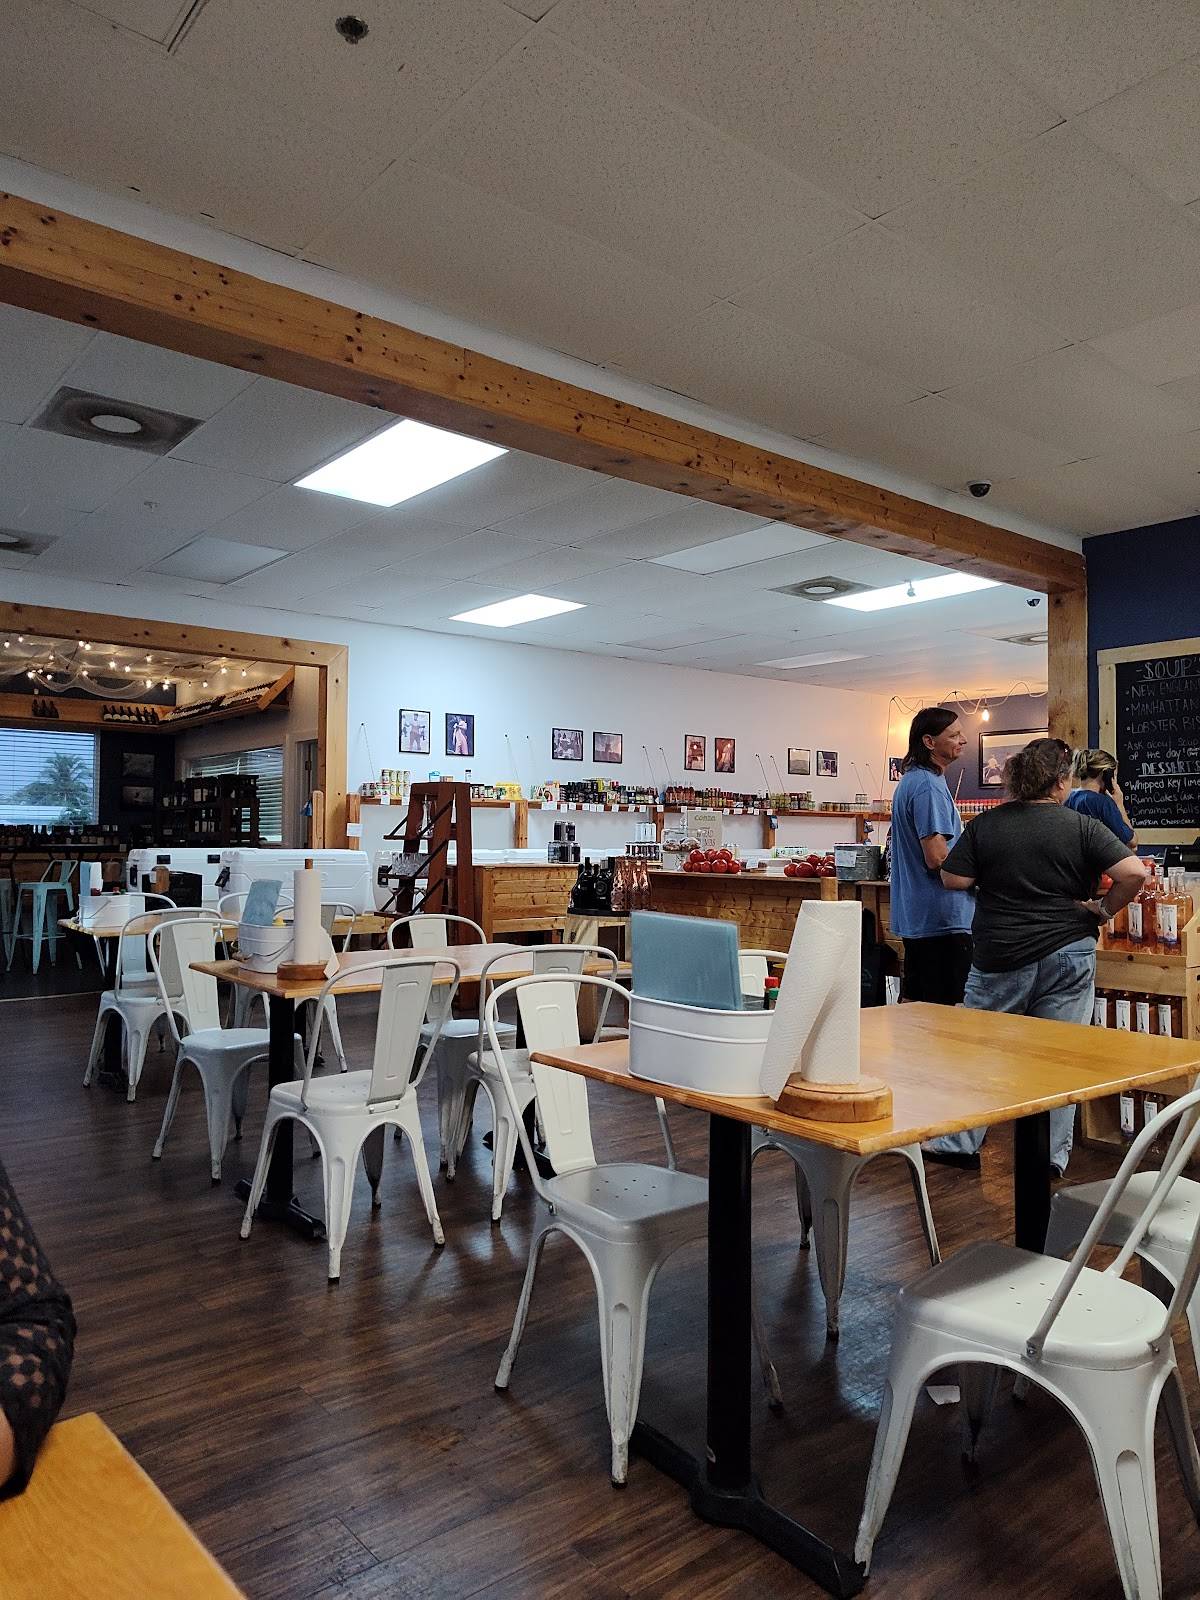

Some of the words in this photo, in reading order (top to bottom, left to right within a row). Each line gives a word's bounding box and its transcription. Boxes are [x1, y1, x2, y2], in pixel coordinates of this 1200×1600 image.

[1131, 684, 1155, 699] NEW
[1131, 718, 1178, 734] LOBSTER
[1129, 751, 1139, 760] of
[1146, 750, 1161, 759] the
[1129, 779, 1165, 793] Whipped
[1167, 778, 1181, 793] Key
[1130, 793, 1153, 804] Rum
[1153, 791, 1178, 803] Cakes
[1132, 805, 1172, 816] Cinnamon
[1176, 802, 1200, 815] Rolls
[1131, 817, 1159, 826] Pumpkin
